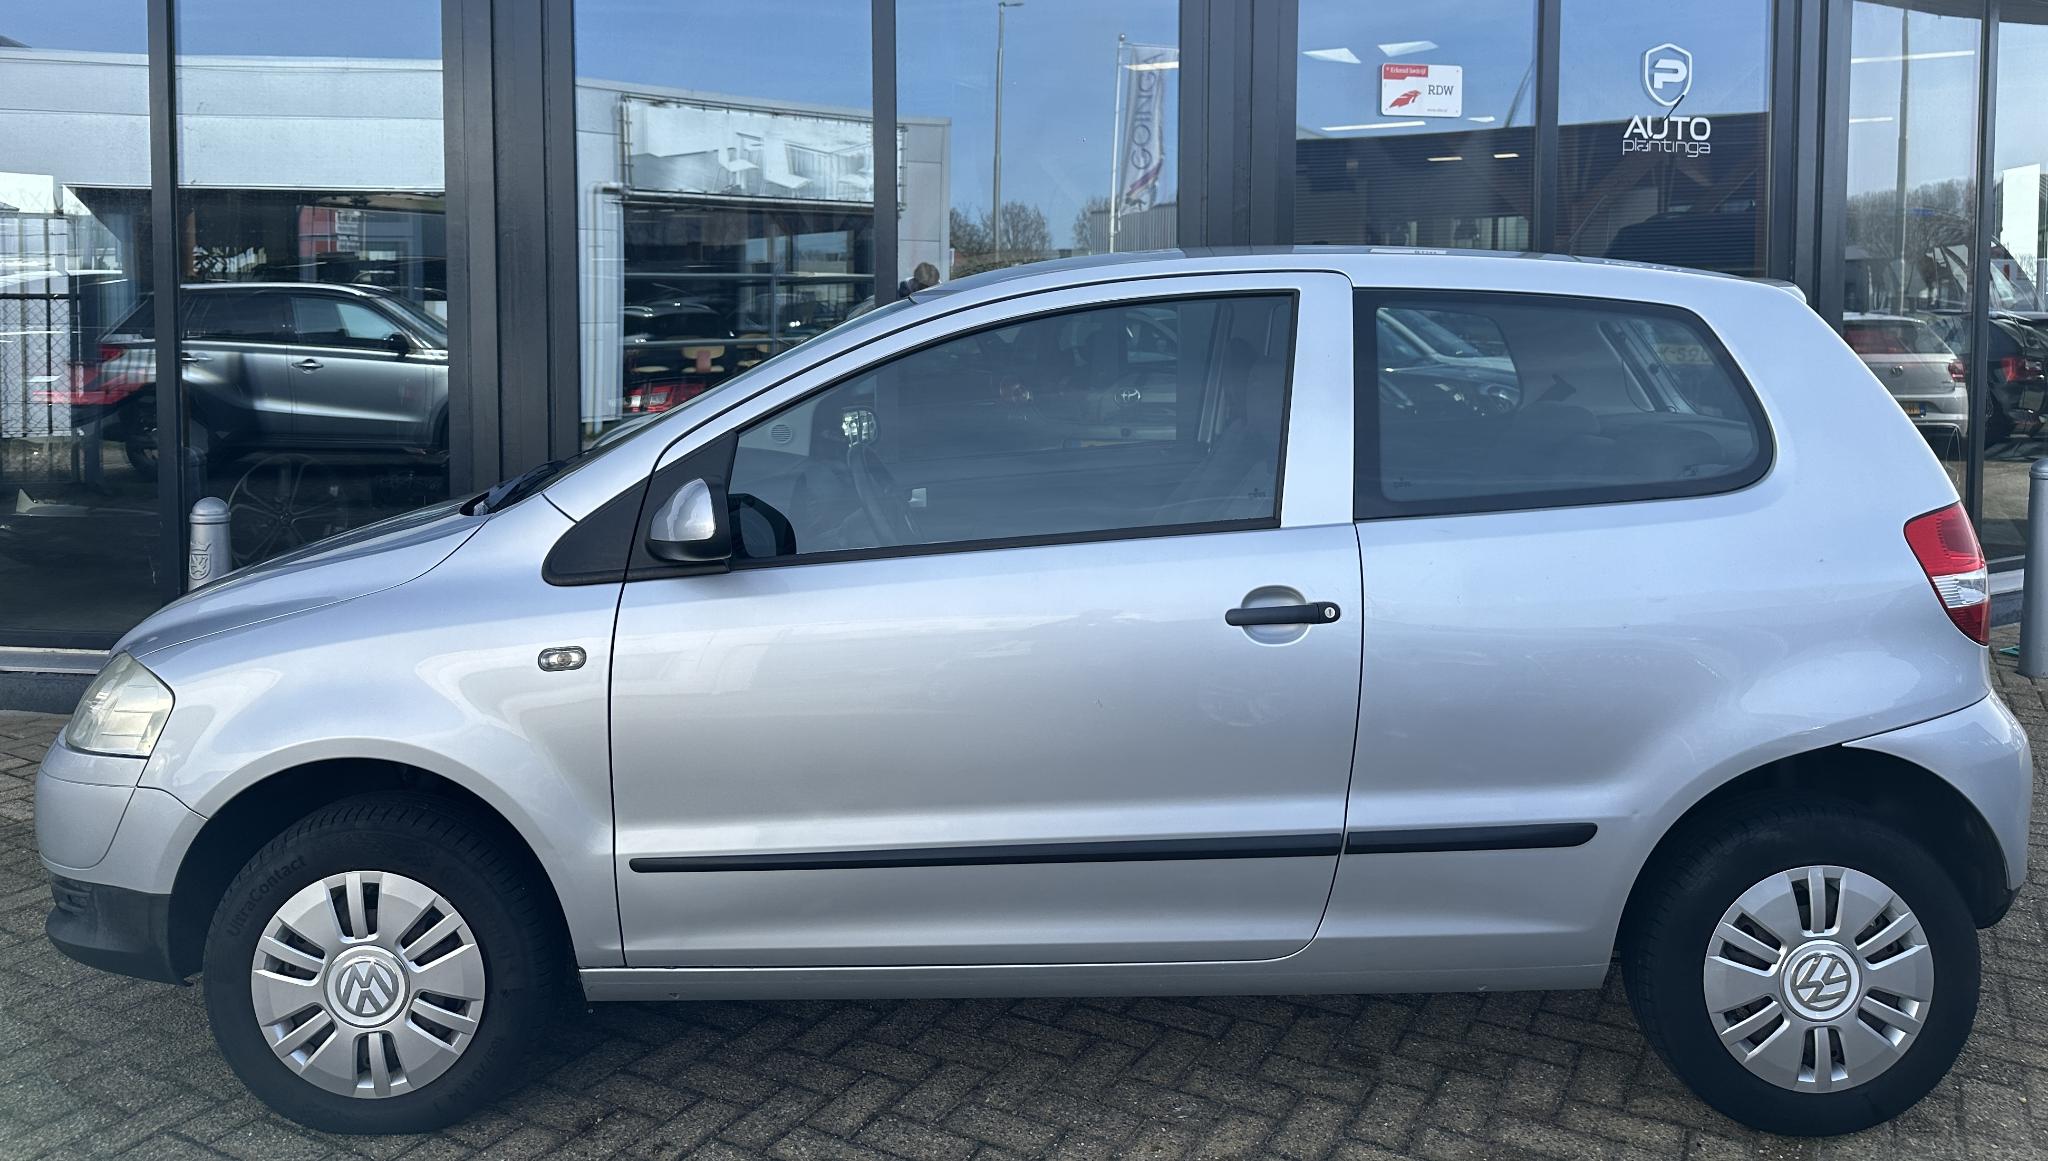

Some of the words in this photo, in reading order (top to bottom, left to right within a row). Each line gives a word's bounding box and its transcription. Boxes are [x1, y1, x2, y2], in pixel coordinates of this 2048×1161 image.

[1428, 85, 1454, 96] RDW
[1623, 115, 1711, 140] AUTO
[1622, 138, 1711, 157] plantinga
[225, 855, 306, 937] UltraContact
